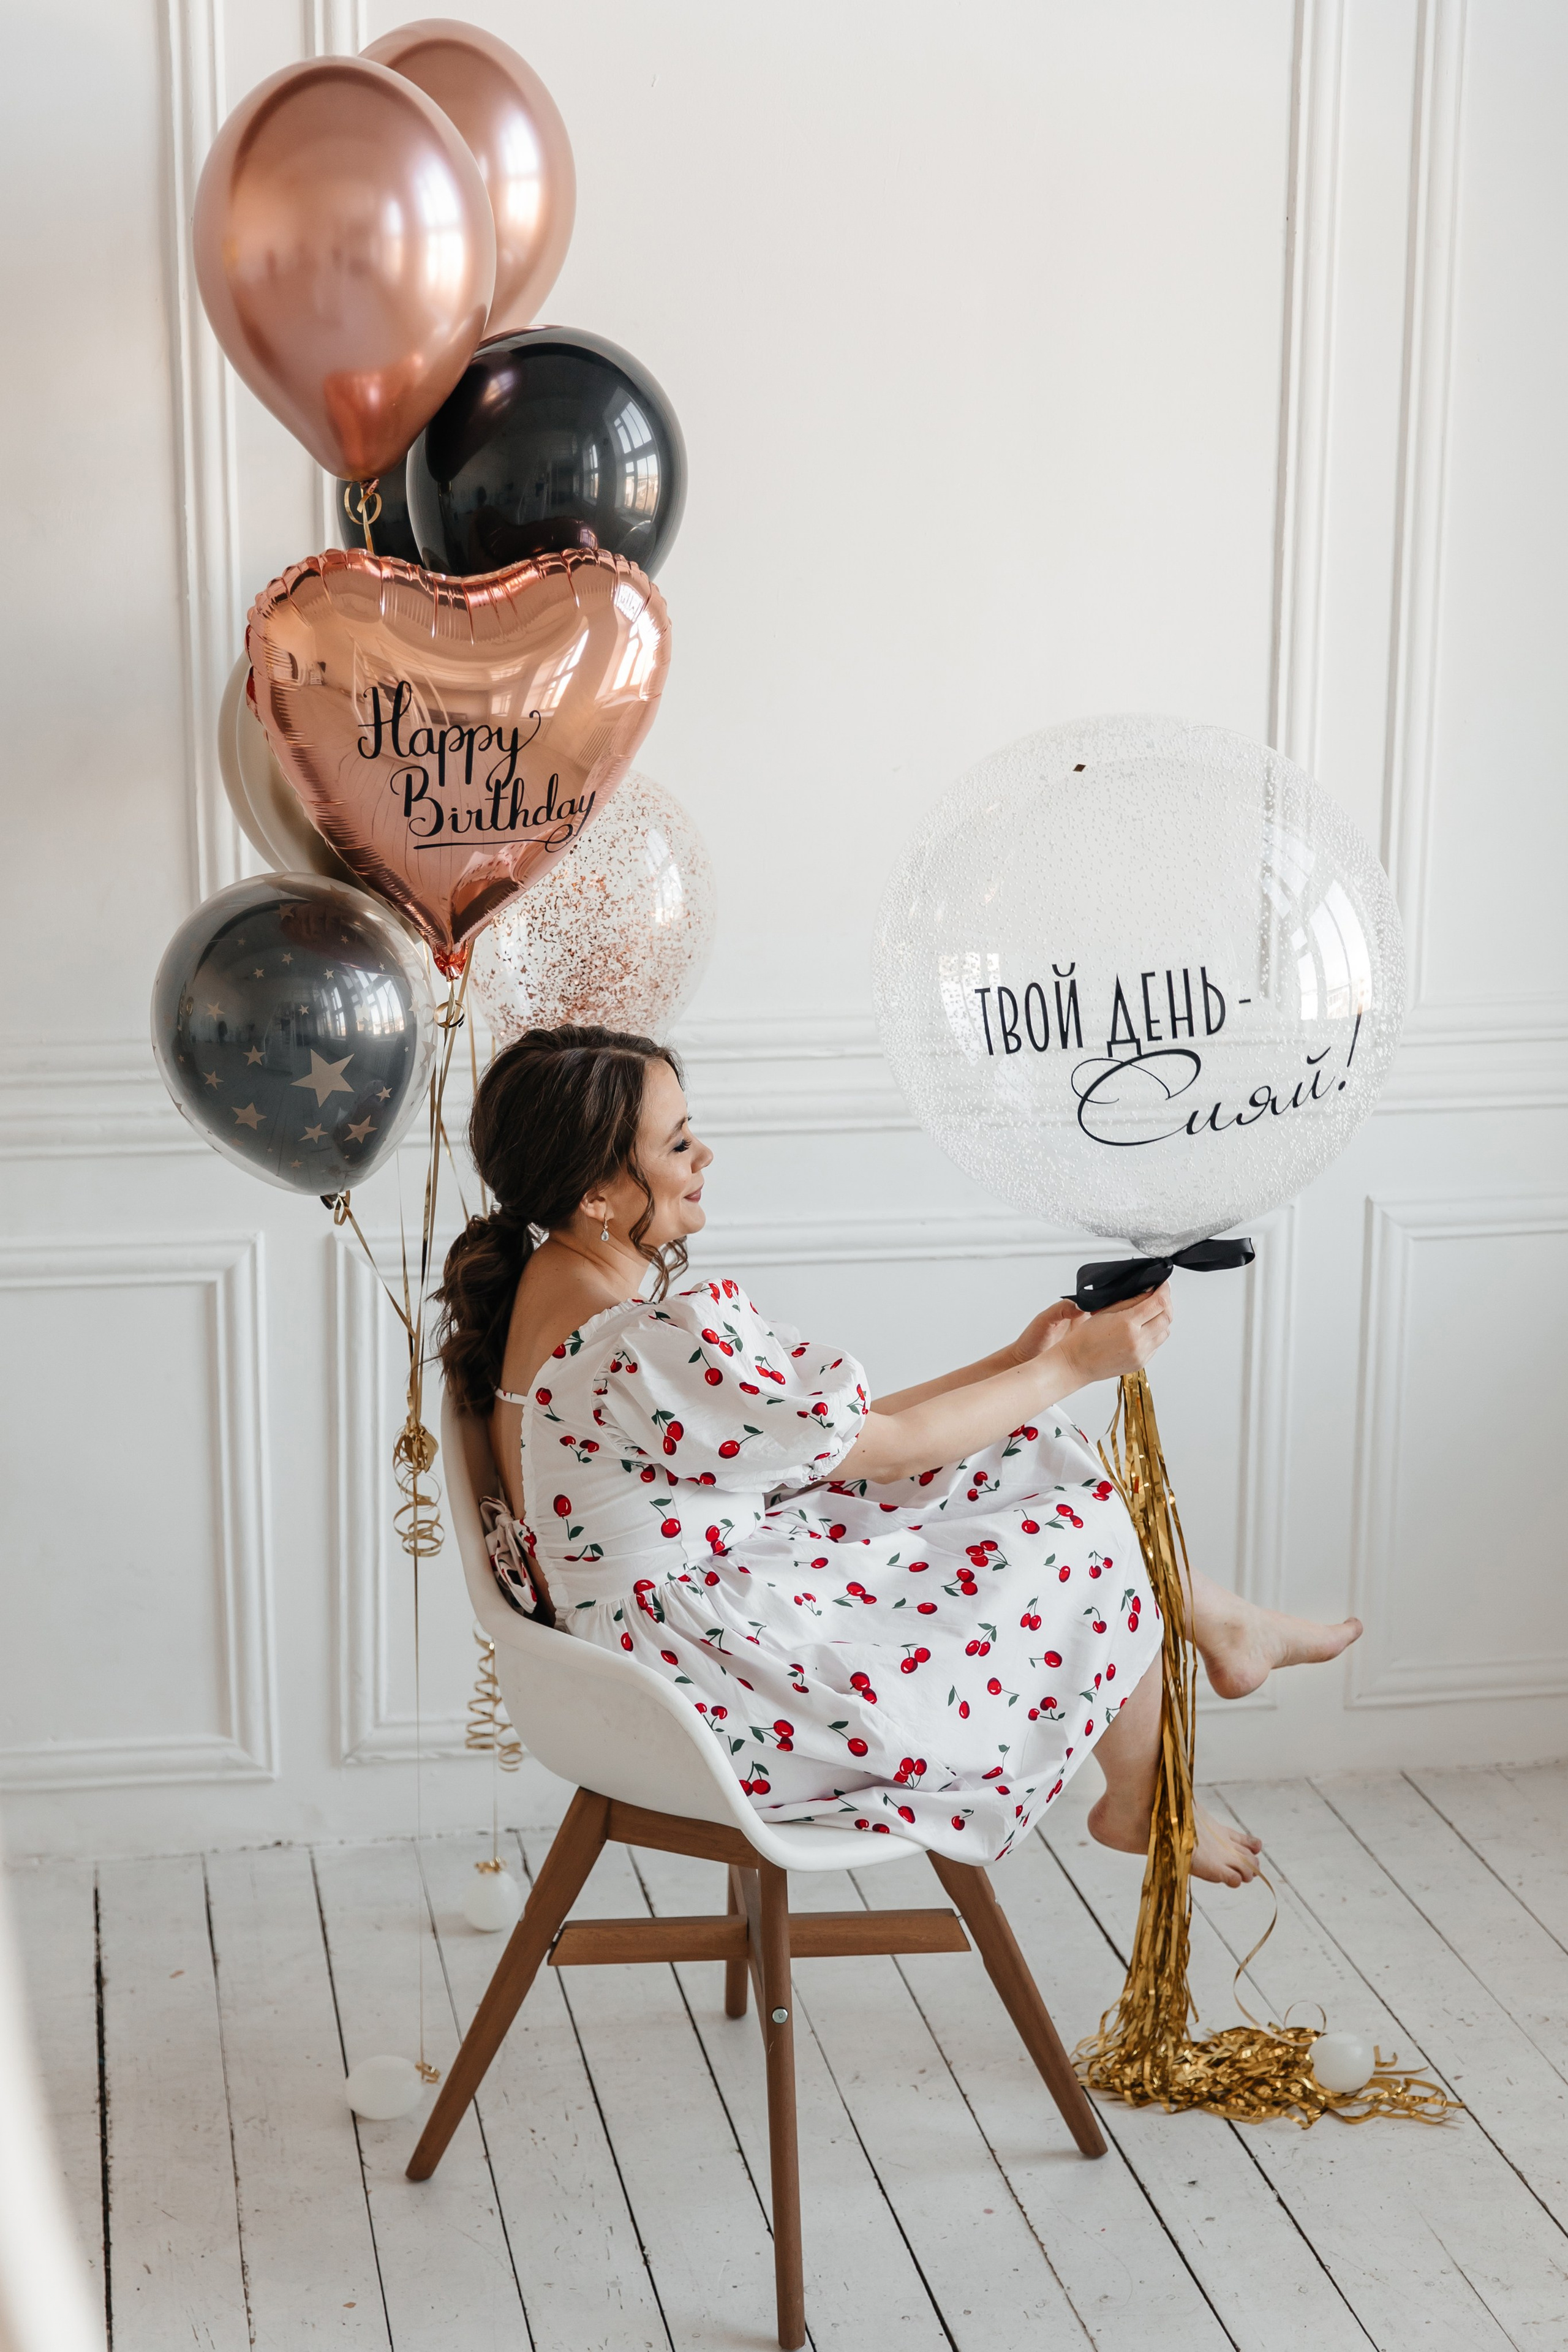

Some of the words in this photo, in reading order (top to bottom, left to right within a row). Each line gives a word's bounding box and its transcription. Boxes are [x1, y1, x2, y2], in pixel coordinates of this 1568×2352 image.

[356, 680, 541, 793] Happy
[389, 765, 596, 854] Birthday
[974, 962, 1084, 1056] ТВОЙ
[1070, 998, 1363, 1147] Сияй!
